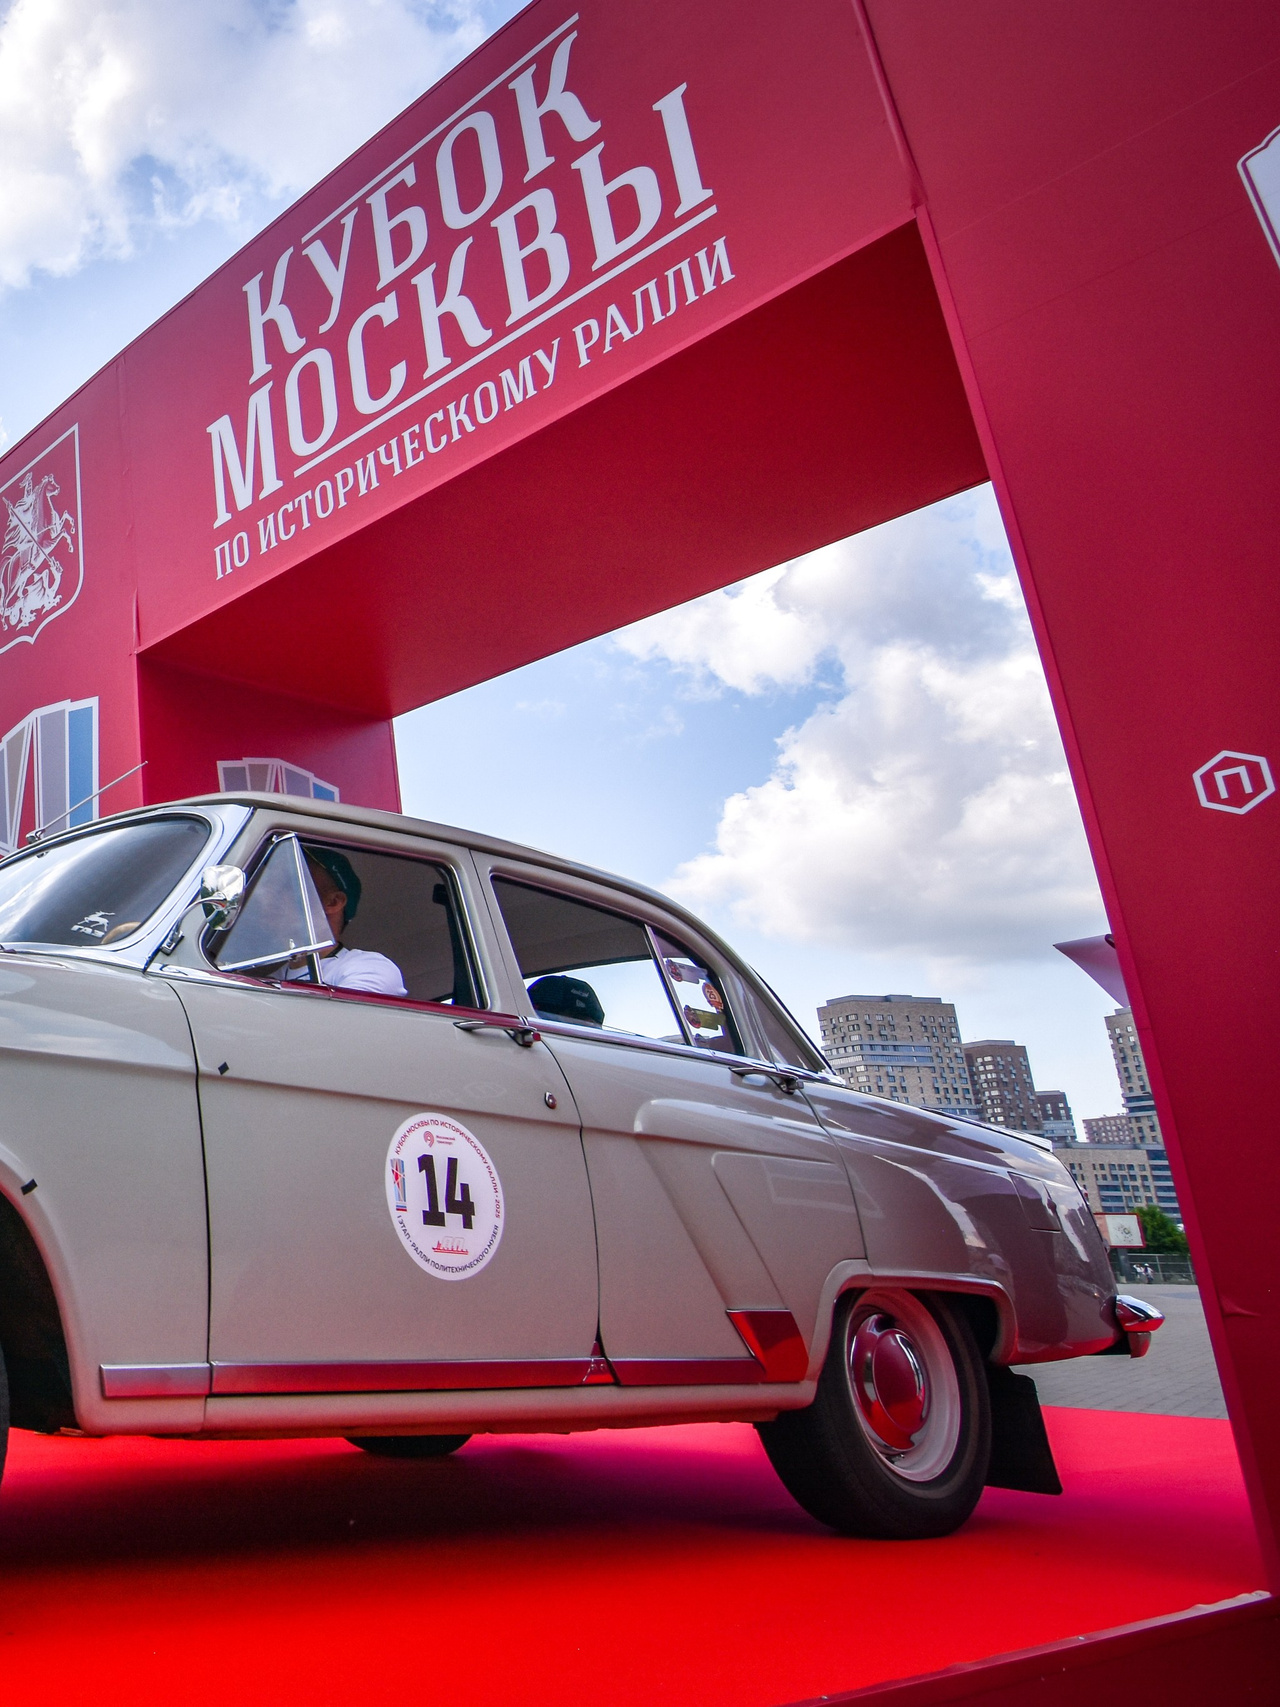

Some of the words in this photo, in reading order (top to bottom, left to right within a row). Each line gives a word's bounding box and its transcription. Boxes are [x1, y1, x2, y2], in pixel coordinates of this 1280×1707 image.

[206, 82, 714, 529] МОСКВЫ
[242, 30, 601, 385] КУБОК
[214, 531, 250, 580] ПО
[257, 339, 561, 555] ИСТОРИЧЕСКОМУ
[572, 236, 736, 368] РАЛЛИ
[394, 1131, 408, 1155] КУБОК
[406, 1119, 430, 1136] МОСКВЫ
[440, 1120, 488, 1164] ИСТОРИЧЕСКОМУ
[486, 1165, 499, 1194] РАЛЛИ
[398, 1219, 411, 1240] ЭТАП
[411, 1242, 431, 1264] РАЛЛИ
[430, 1247, 489, 1273] ПОЛИТЕХНИЧЕСКОГО
[487, 1224, 499, 1249] МУЗЕЯ
[417, 1153, 475, 1230] 14
